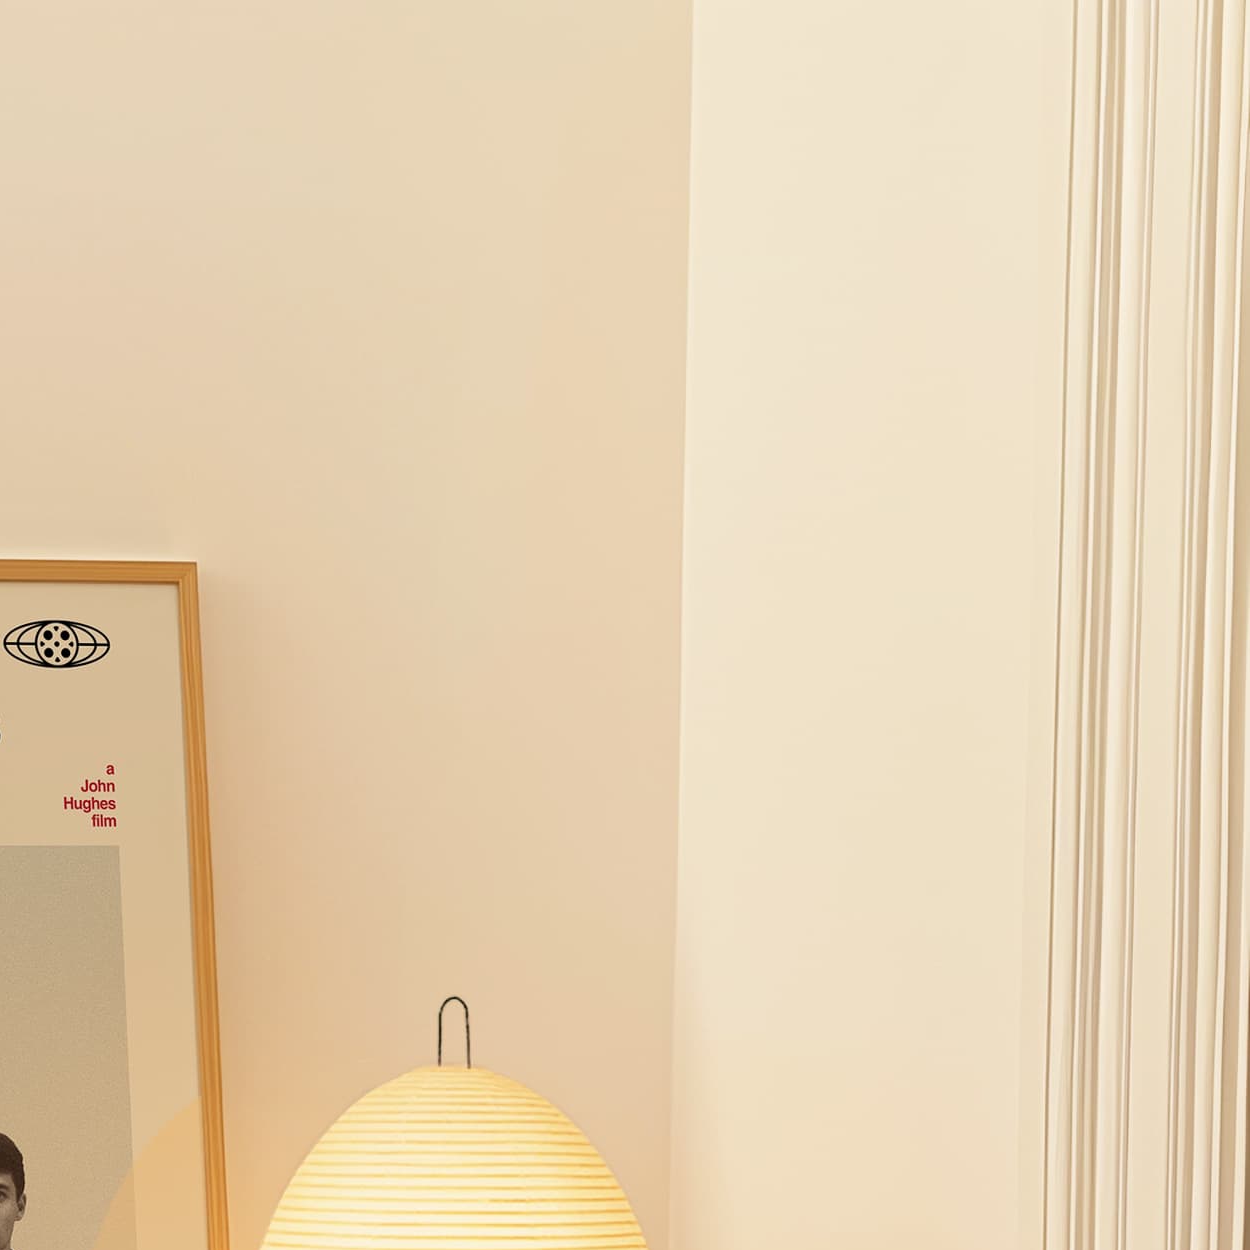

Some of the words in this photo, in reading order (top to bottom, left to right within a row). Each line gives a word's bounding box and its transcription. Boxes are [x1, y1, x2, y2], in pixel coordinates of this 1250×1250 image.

[106, 764, 115, 775] a
[80, 779, 116, 793] John
[63, 796, 116, 813] Hughes
[91, 814, 117, 827] film
